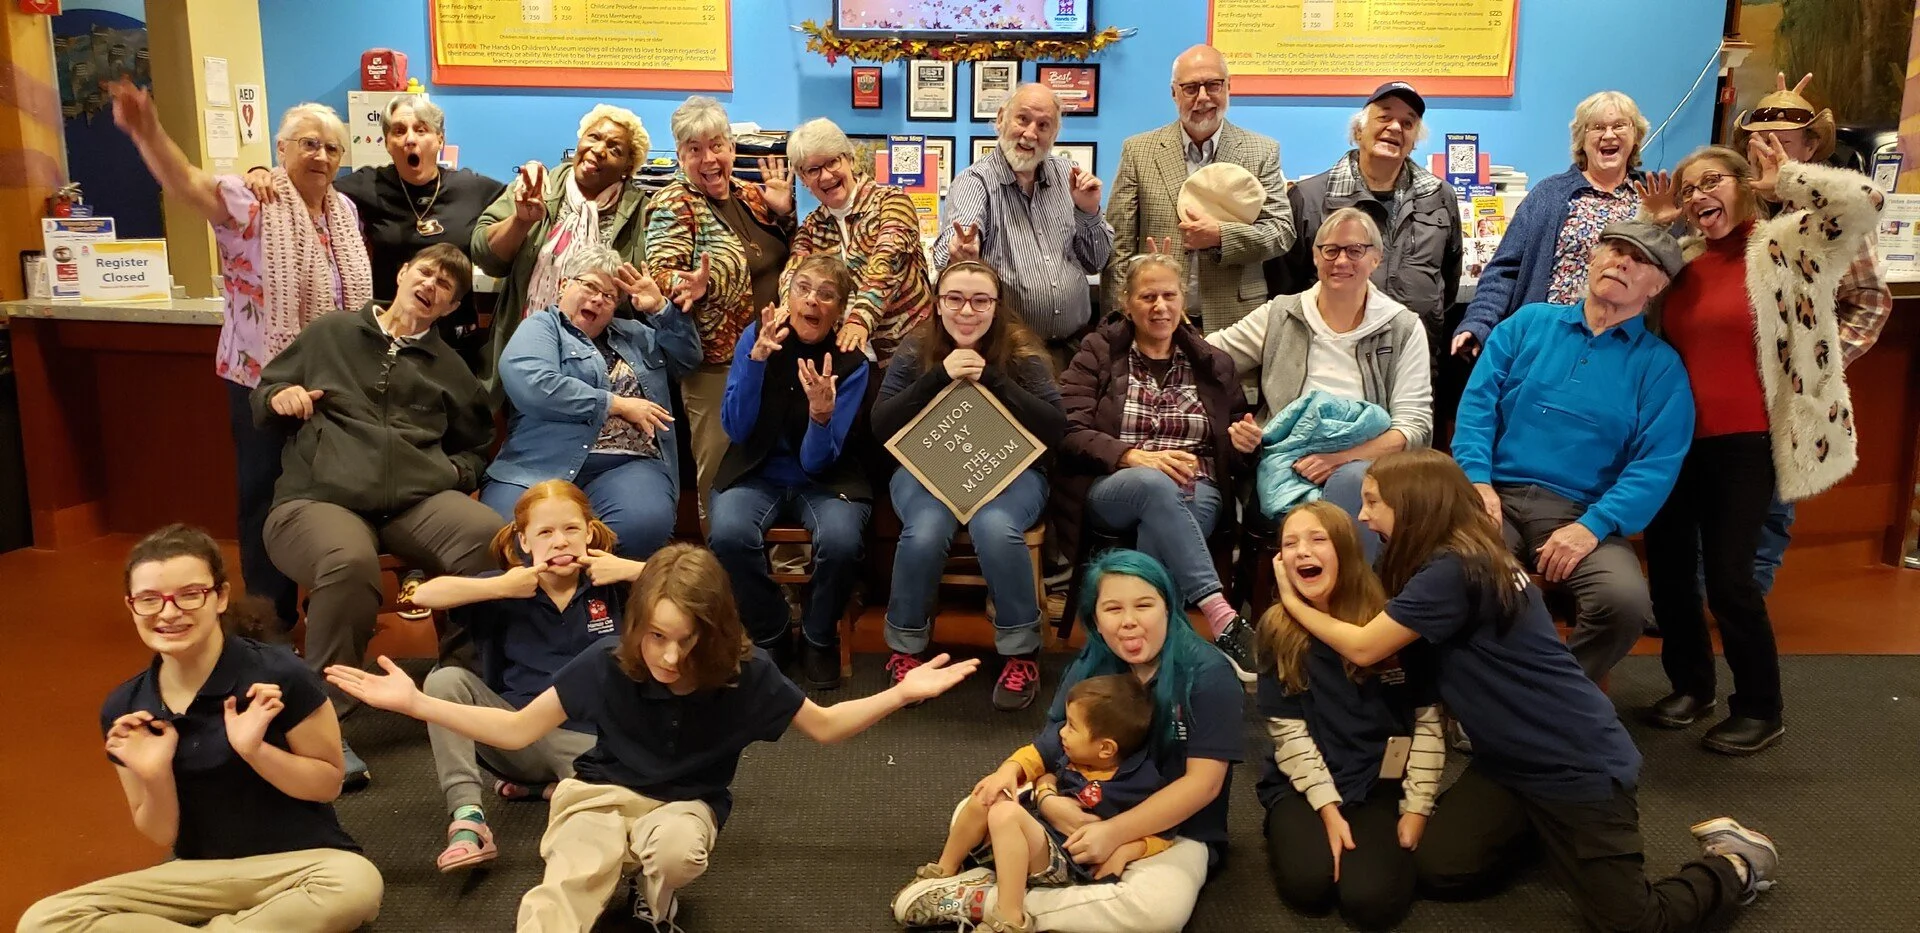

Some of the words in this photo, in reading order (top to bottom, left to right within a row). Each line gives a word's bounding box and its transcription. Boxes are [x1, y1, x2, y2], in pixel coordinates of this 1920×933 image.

[239, 89, 255, 100] AED
[96, 258, 149, 269] Register
[102, 272, 145, 282] Closed
[922, 400, 973, 449] SENIOR
[944, 424, 972, 452] DAY
[962, 442, 973, 453] @
[961, 439, 1019, 493] MUSEUM
[962, 448, 990, 473] THE
